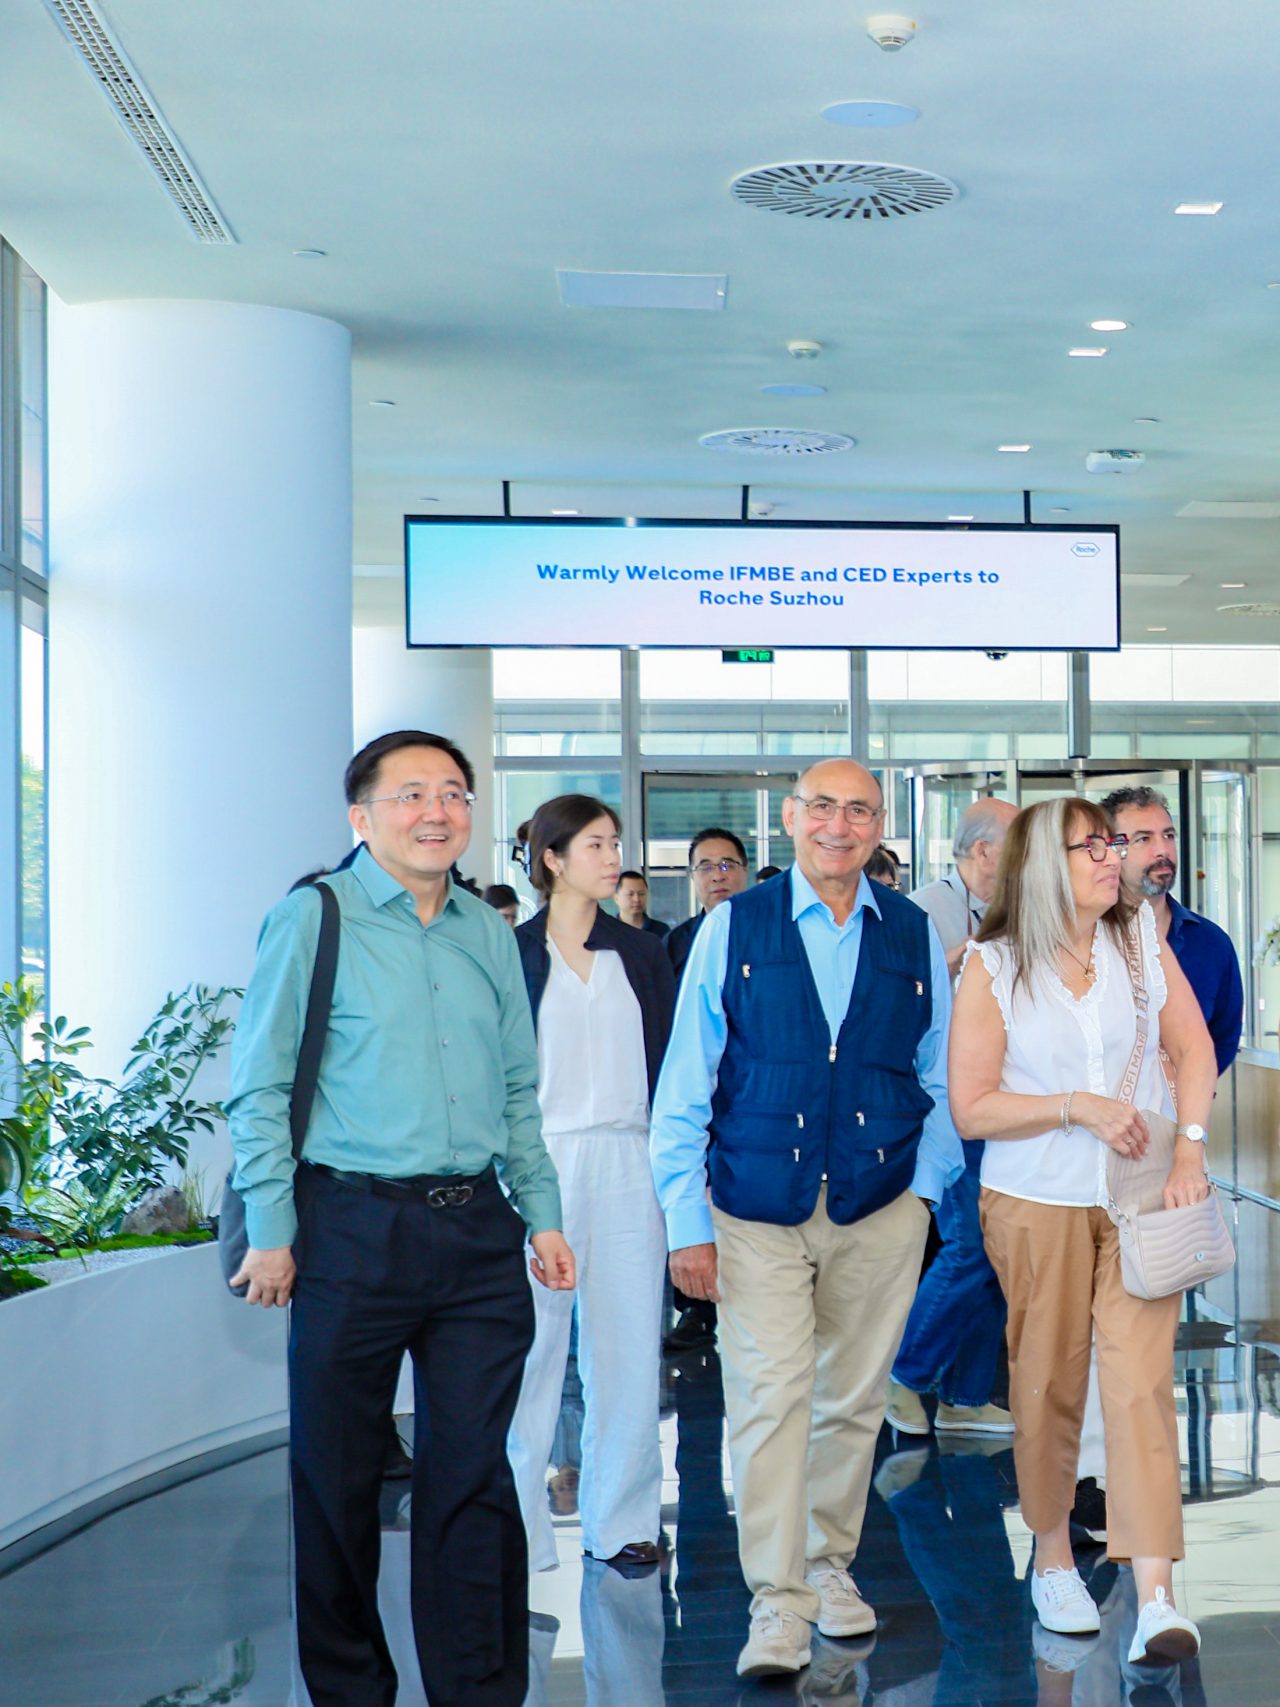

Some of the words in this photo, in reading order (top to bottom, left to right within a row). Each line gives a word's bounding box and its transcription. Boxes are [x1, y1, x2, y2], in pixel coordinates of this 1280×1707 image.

[536, 564, 620, 583] Warmly
[626, 565, 724, 581] Welcome
[730, 566, 795, 581] IFMBE
[801, 567, 838, 582] and
[843, 567, 887, 582] CED
[893, 568, 973, 586] Experts
[978, 570, 1000, 583] to
[700, 590, 764, 605] Roche
[770, 590, 844, 606] Suzhou
